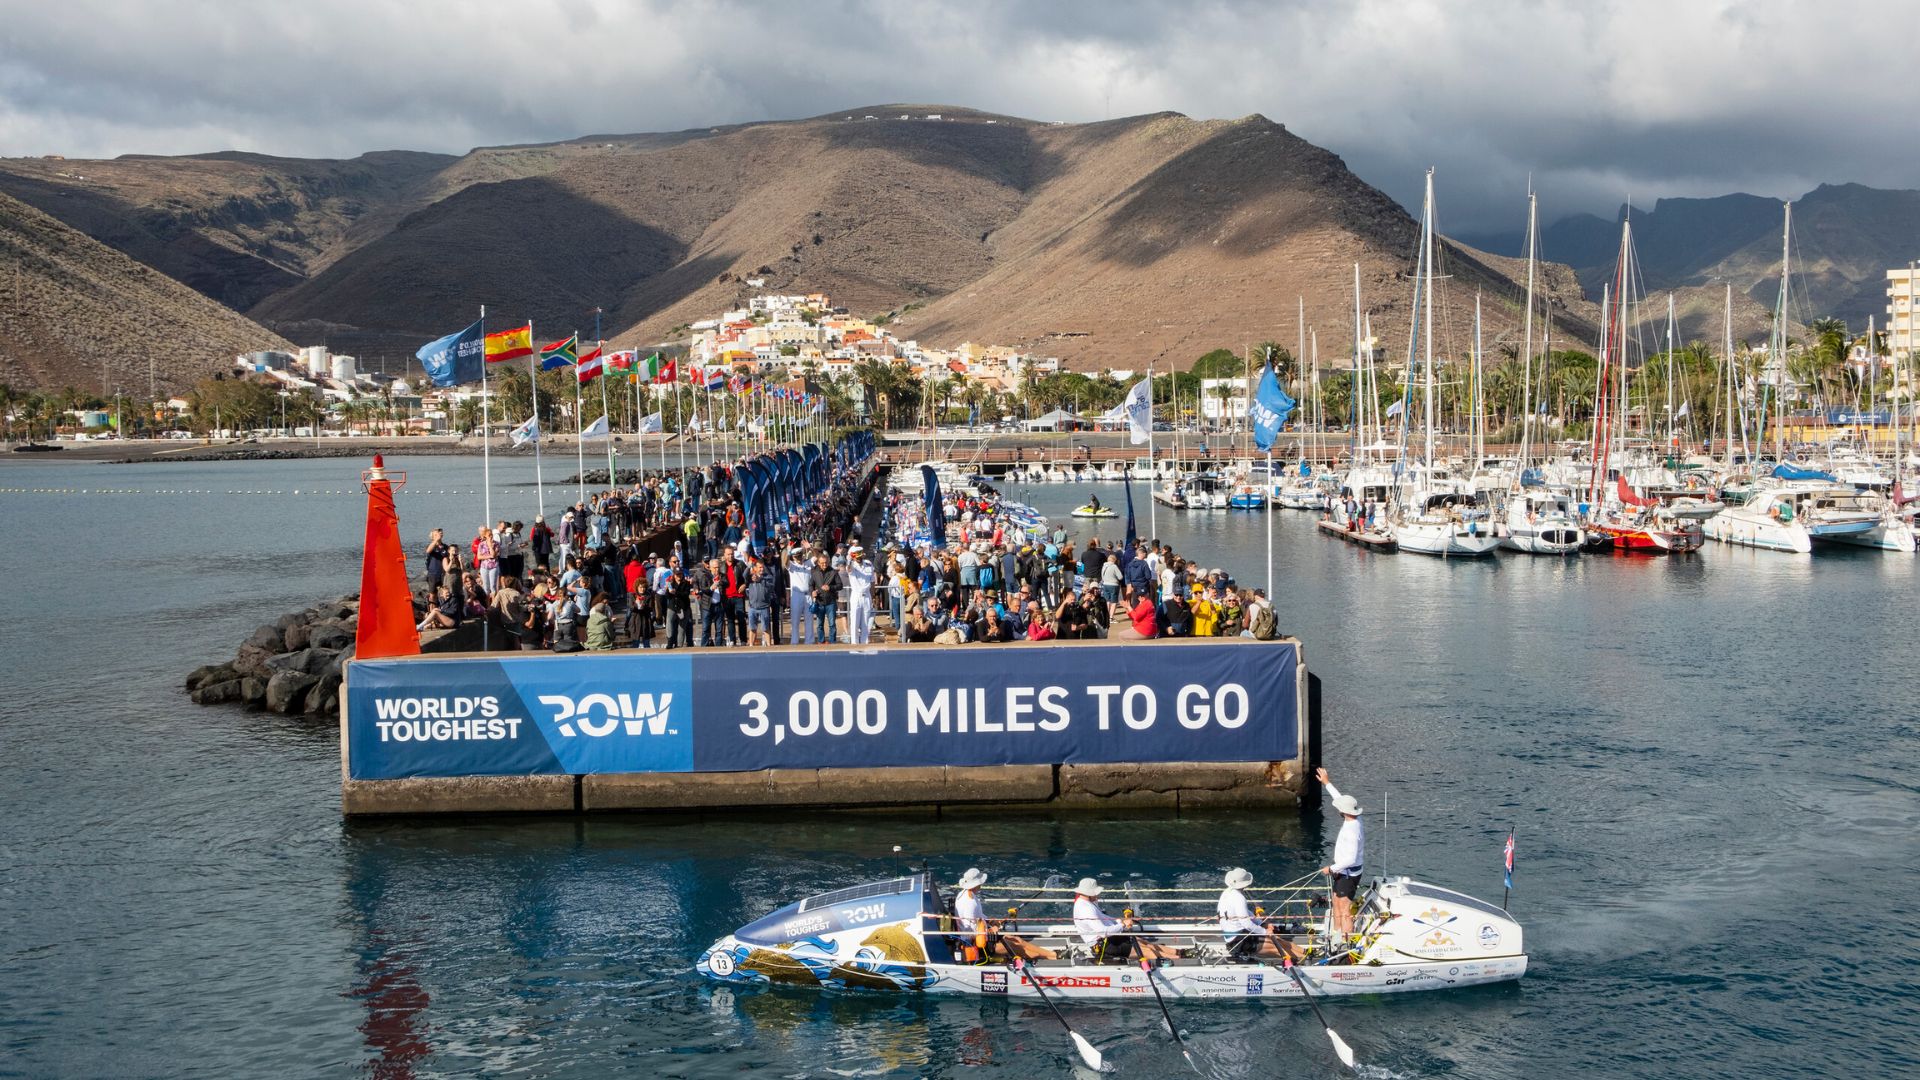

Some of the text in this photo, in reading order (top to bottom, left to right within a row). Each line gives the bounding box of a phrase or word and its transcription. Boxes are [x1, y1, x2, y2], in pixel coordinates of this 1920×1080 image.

[375, 696, 500, 720] WORLD'S
[537, 692, 673, 737] ROW
[739, 683, 1250, 746] 3,000 MILES TO GO
[375, 718, 522, 742] TOUGHEST
[784, 915, 823, 930] WORLD'S
[842, 903, 886, 924] ROW
[784, 921, 831, 938] TOUGHEST
[716, 959, 728, 970] 13
